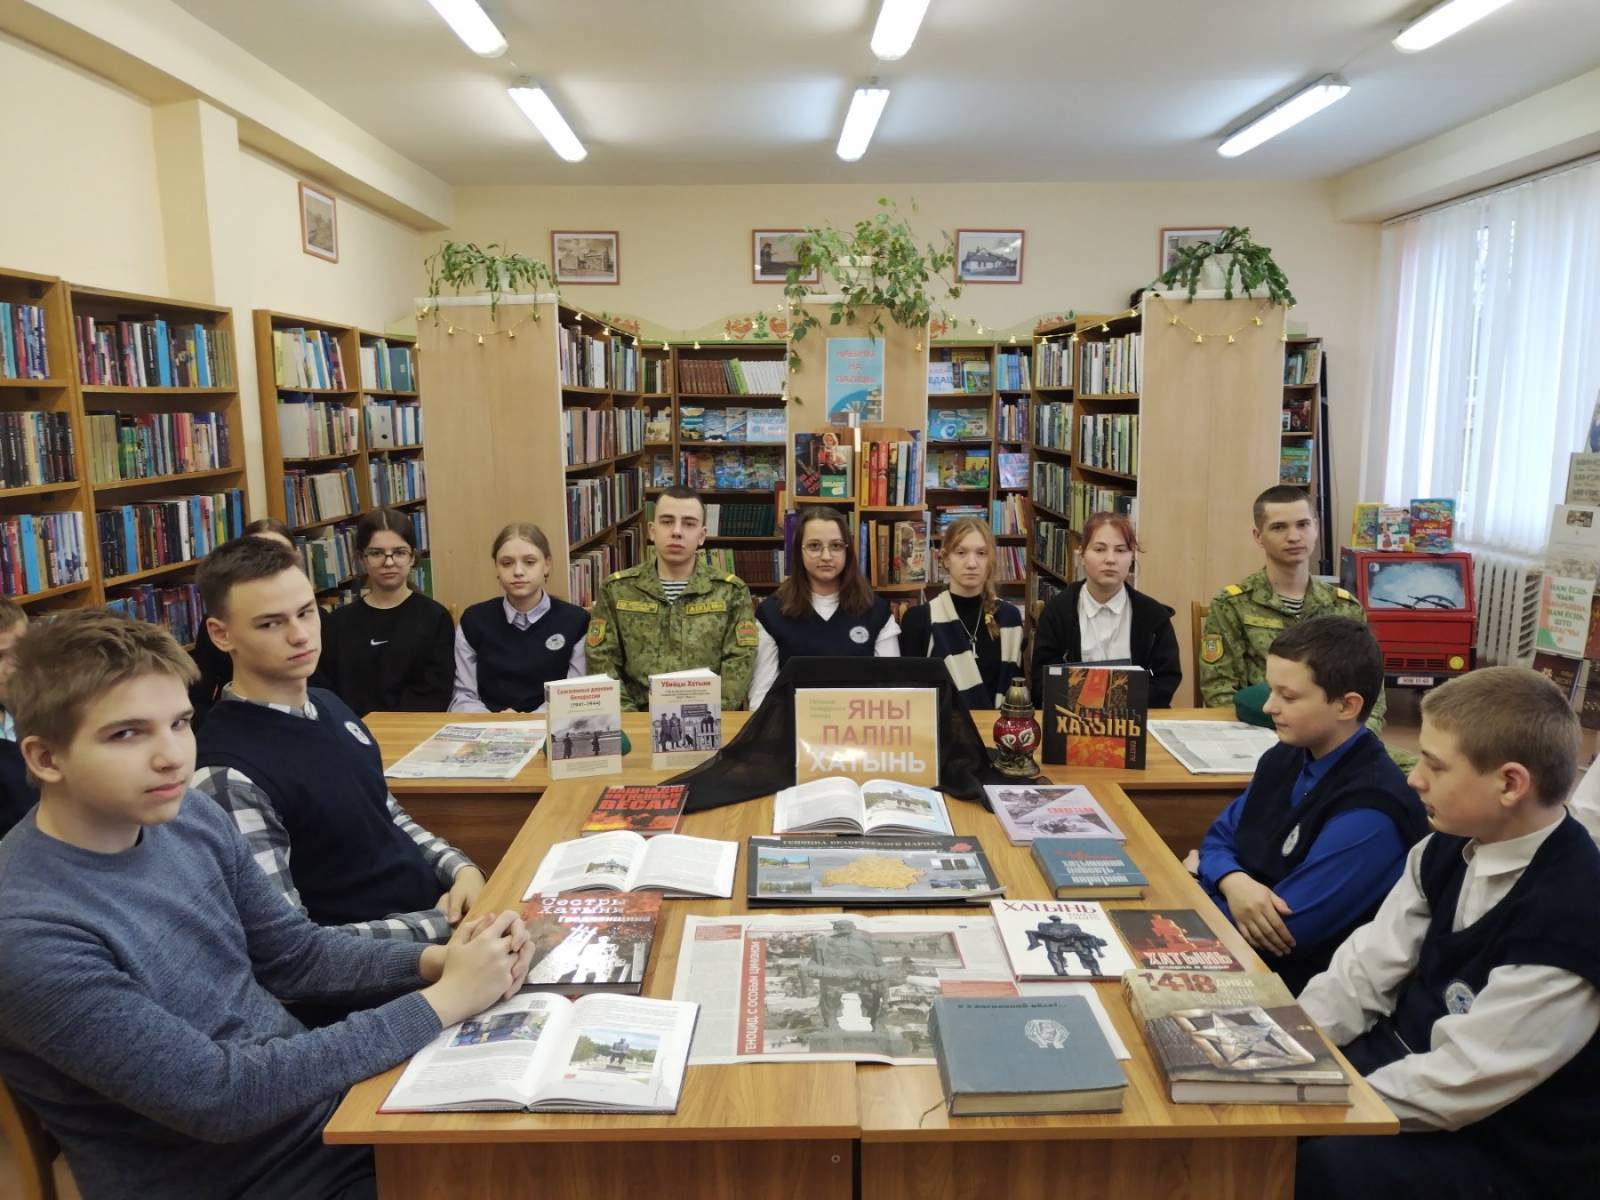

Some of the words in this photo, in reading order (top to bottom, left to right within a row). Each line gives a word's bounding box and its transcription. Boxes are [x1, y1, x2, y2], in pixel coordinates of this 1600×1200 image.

[847, 699, 911, 720] ЯНЫ
[822, 725, 912, 747] ПАЛІЛІ
[1056, 715, 1141, 737] ХАТЫНЬ
[809, 751, 926, 773] ХАТЫНЬ
[1001, 902, 1097, 914] ХАТЫНЬ
[1143, 951, 1233, 966] ХАТЫНЬ
[747, 975, 759, 1008] ОСОБЫМ
